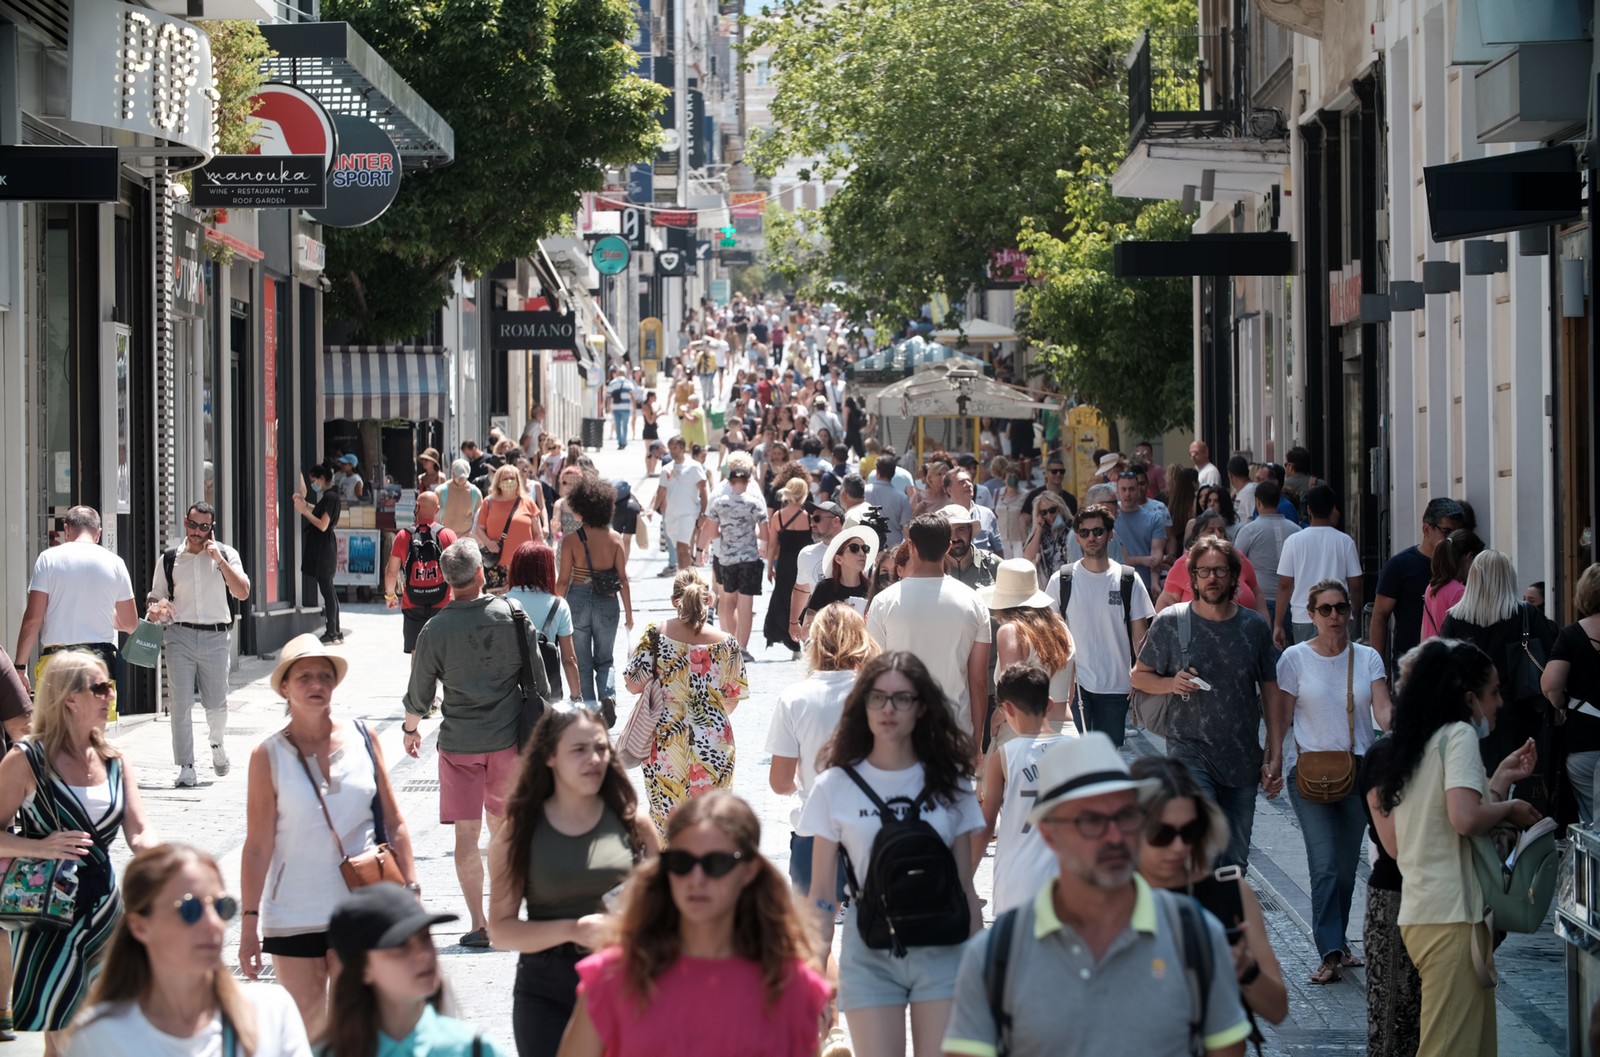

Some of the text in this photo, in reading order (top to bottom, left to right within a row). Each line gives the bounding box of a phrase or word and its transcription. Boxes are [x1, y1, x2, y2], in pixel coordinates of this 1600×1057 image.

[335, 153, 393, 170] INTER
[207, 160, 311, 184] manouka
[333, 170, 393, 187] SPORT
[500, 323, 573, 338] ROMANO
